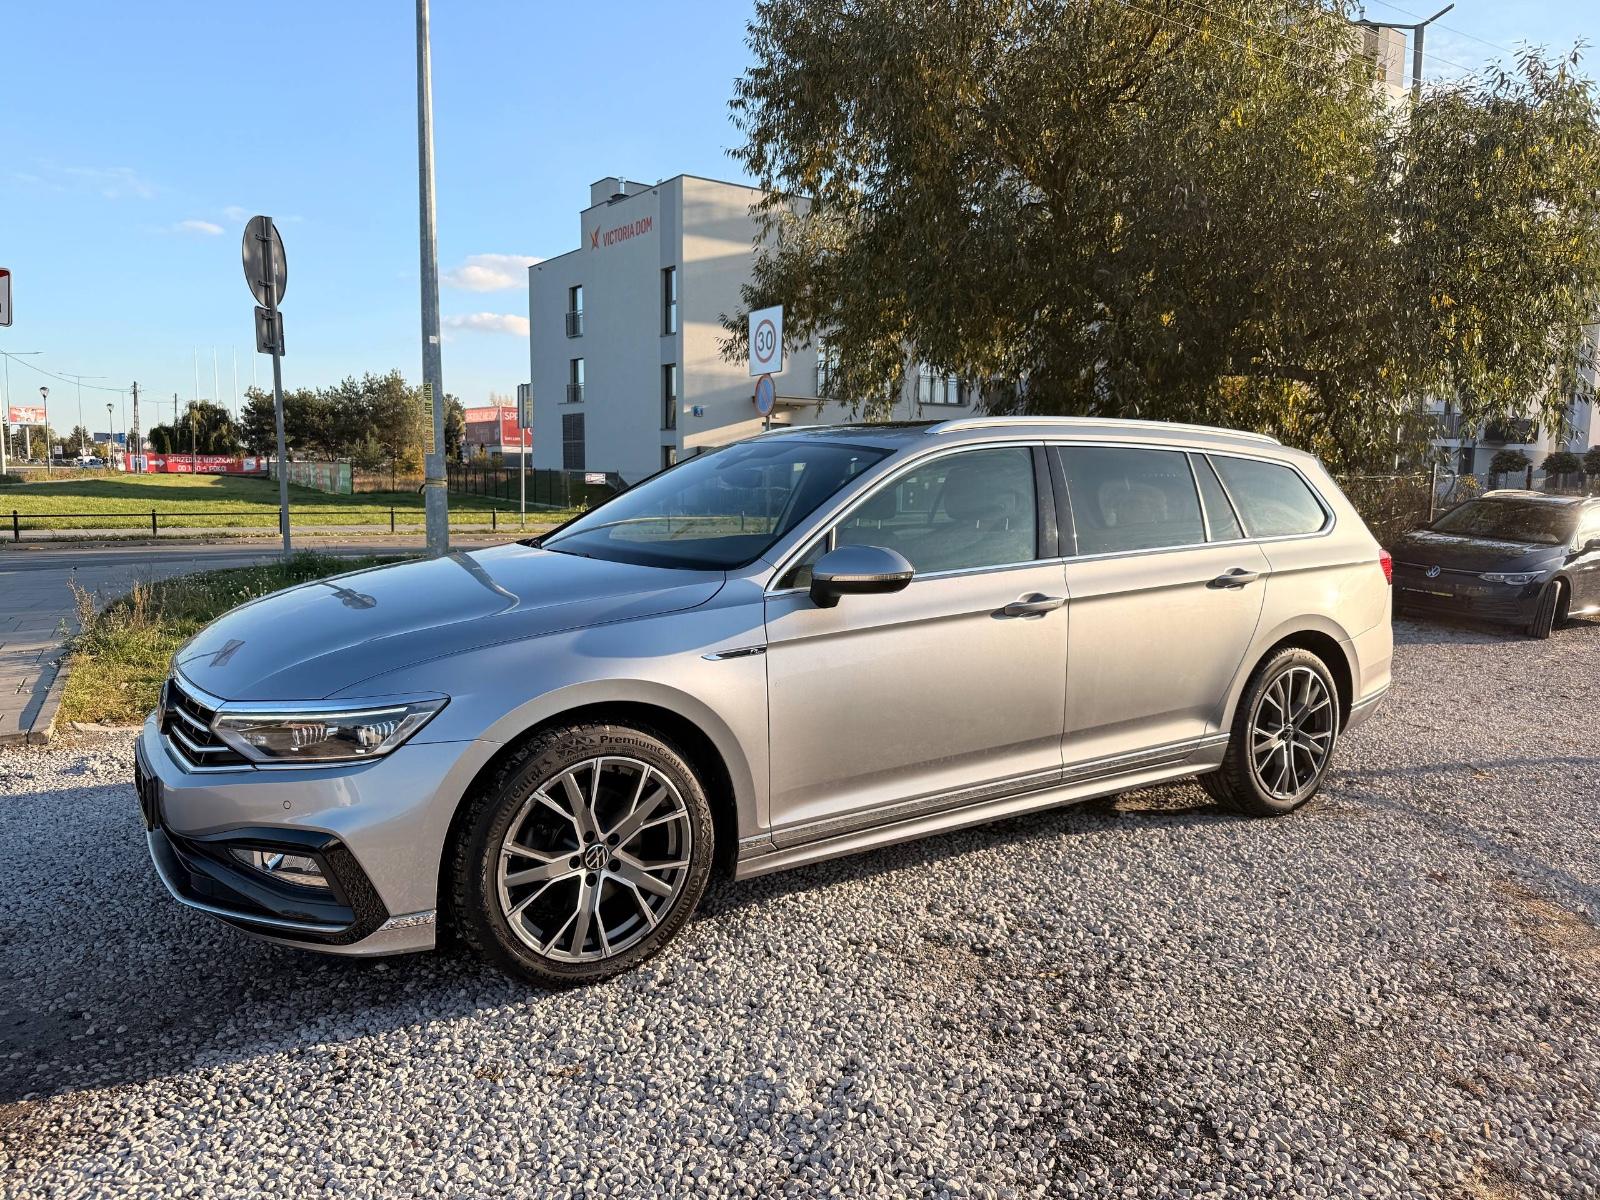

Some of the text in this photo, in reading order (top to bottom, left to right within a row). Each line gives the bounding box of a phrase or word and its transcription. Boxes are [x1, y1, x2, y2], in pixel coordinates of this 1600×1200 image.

[603, 216, 653, 247] VICTORIA DOM
[757, 330, 773, 352] 30
[423, 383, 432, 401] SKUP
[424, 402, 433, 415] AUT
